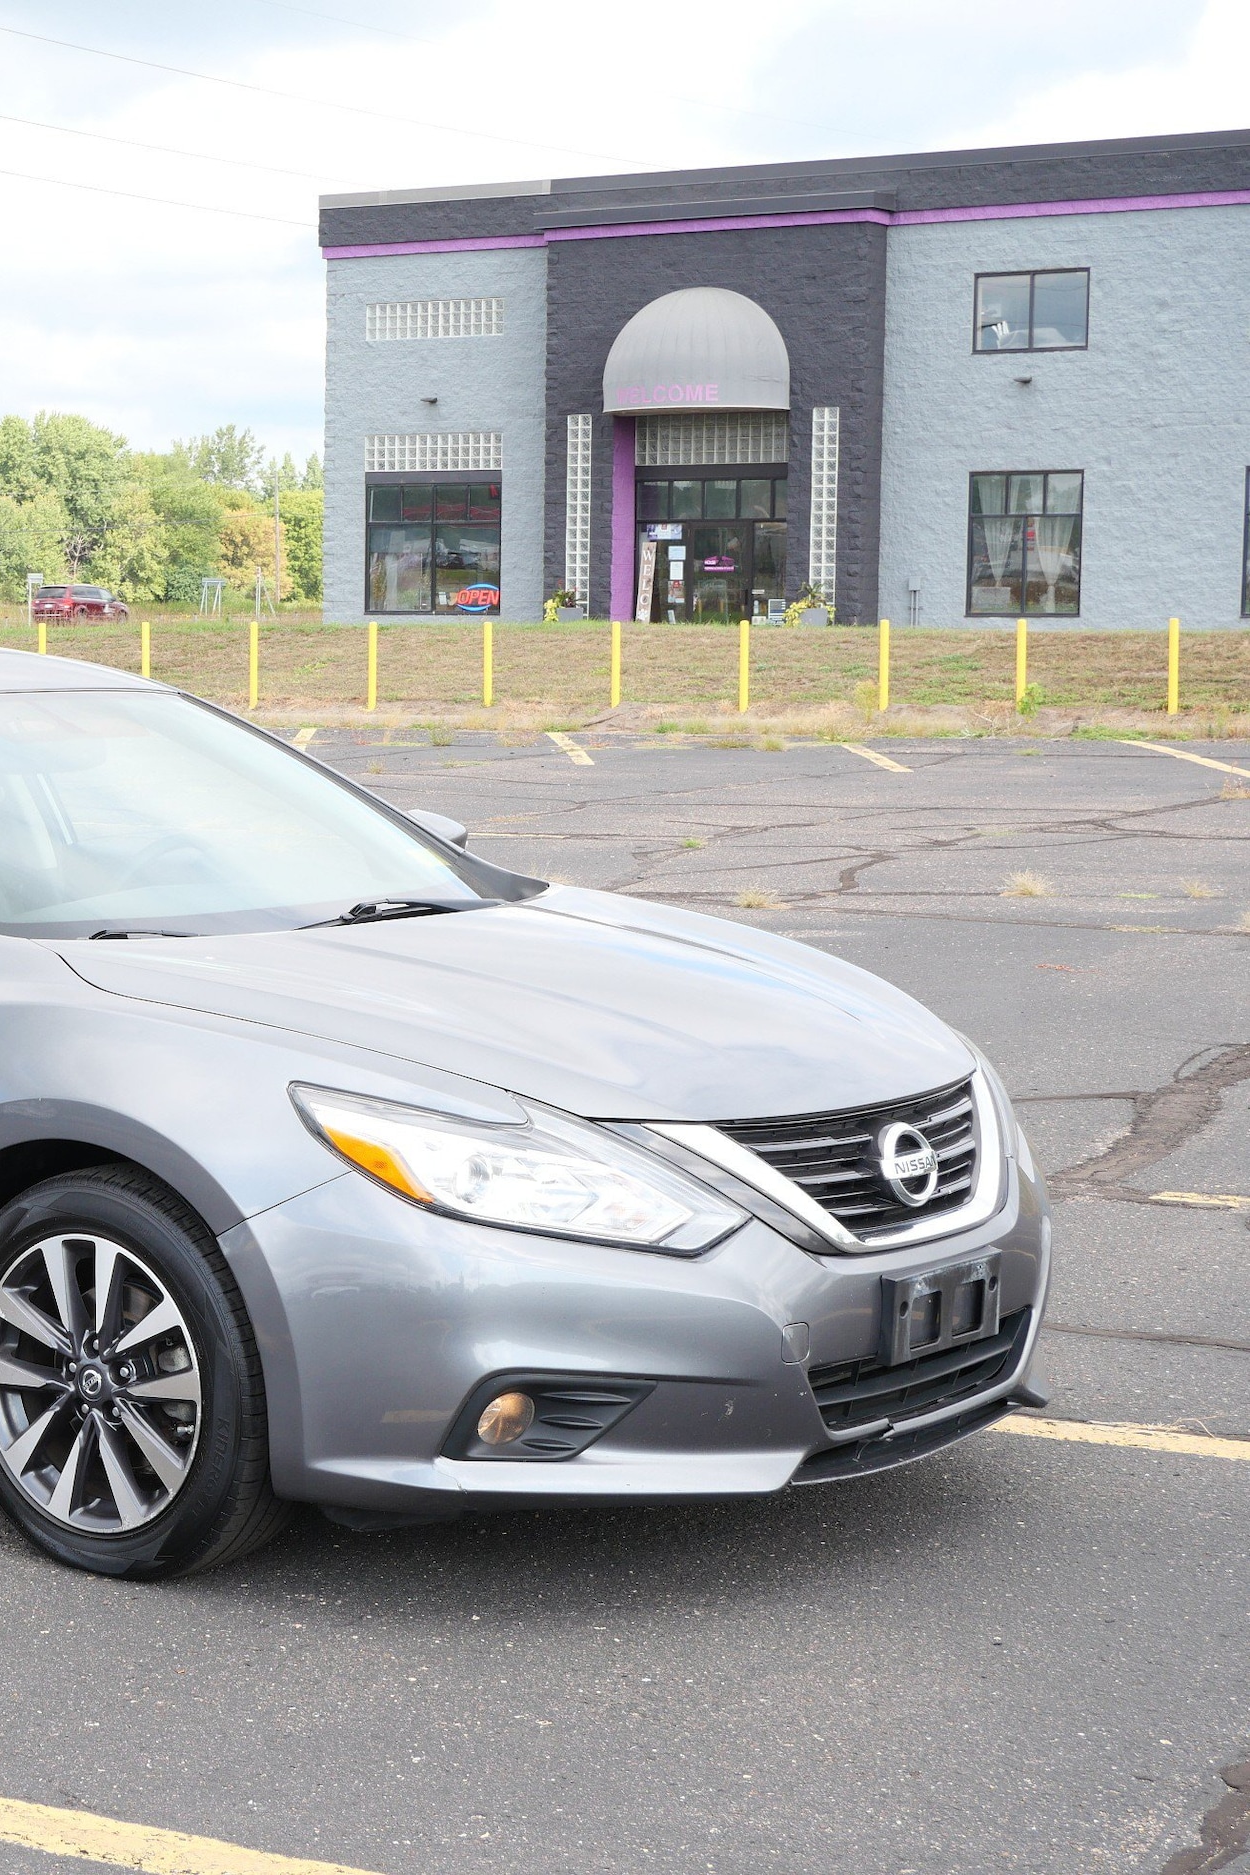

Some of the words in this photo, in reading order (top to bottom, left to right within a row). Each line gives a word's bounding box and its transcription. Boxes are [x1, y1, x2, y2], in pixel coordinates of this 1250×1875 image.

[616, 384, 719, 404] WELCOME
[457, 589, 500, 606] OPEN
[894, 1154, 937, 1175] NISSAN
